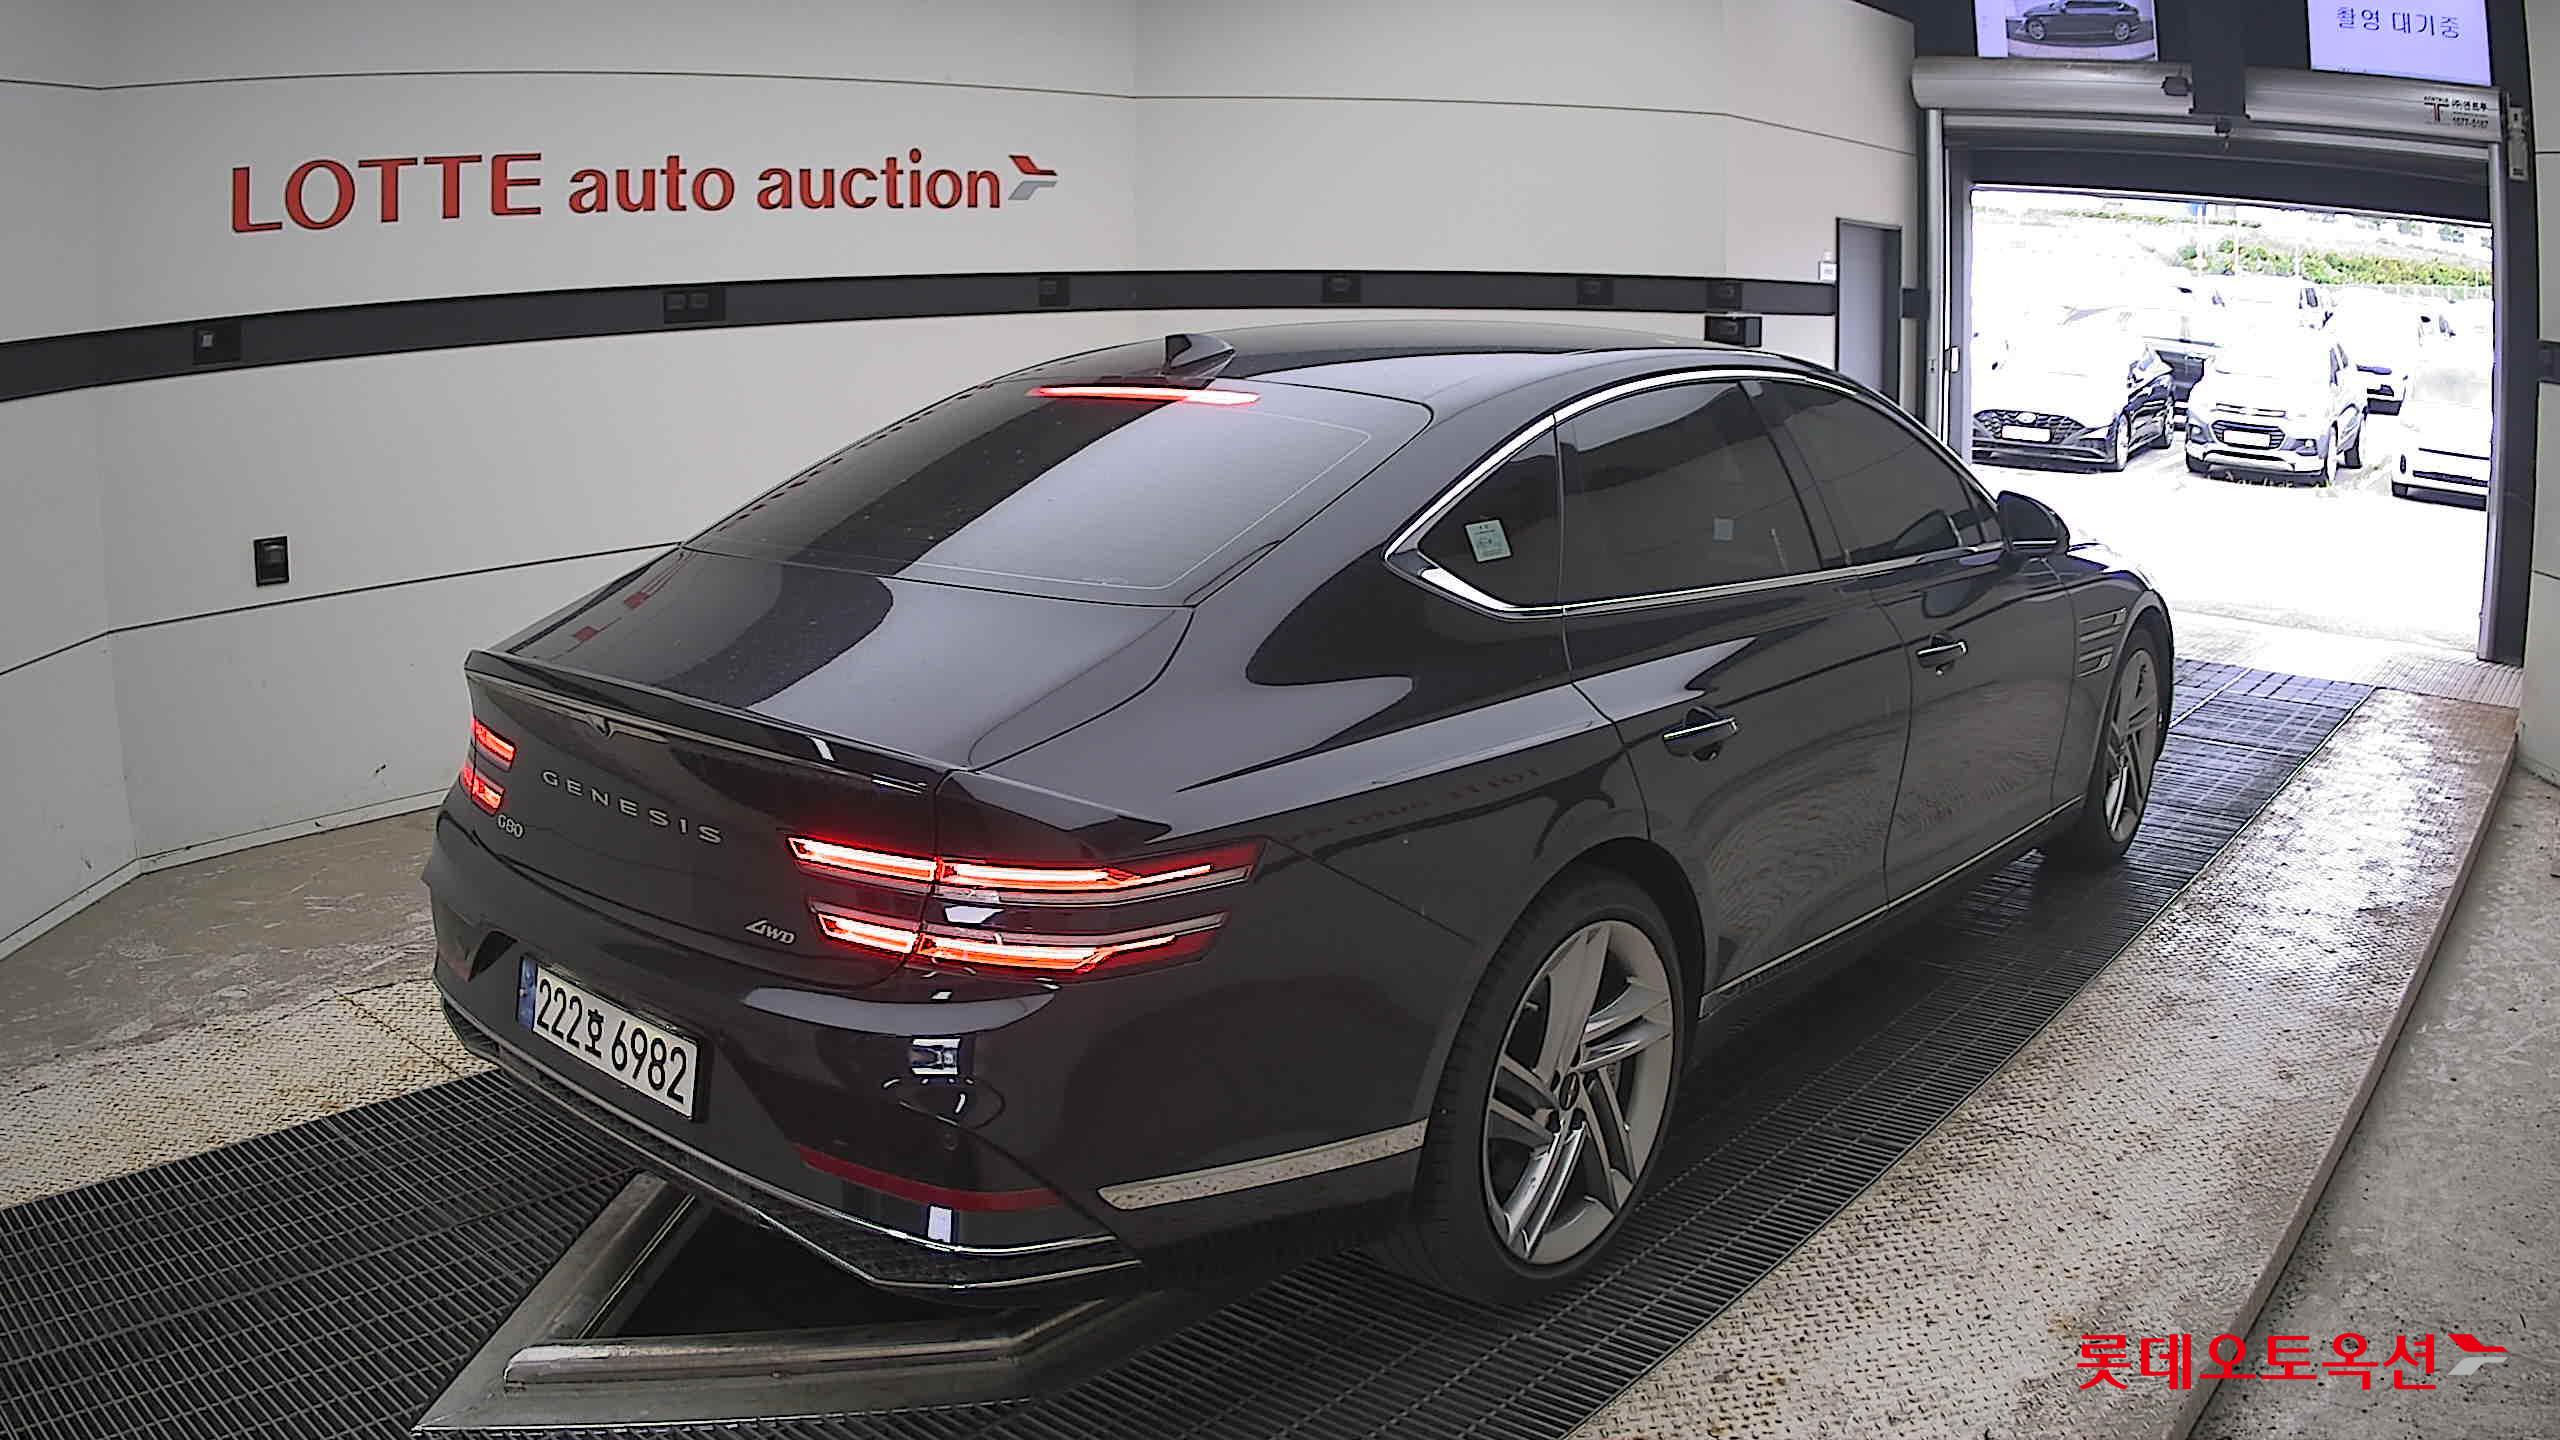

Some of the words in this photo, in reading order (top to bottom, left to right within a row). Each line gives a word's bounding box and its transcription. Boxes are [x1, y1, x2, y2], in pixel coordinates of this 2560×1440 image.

[2336, 6, 2381, 31] 촬영
[2391, 11, 2460, 39] 대기중
[232, 153, 542, 233] LOTTE
[568, 154, 735, 214] auto
[757, 148, 1001, 210] auction
[542, 771, 723, 844] GENESIS
[496, 814, 524, 839] G80
[744, 919, 796, 945] 4WD
